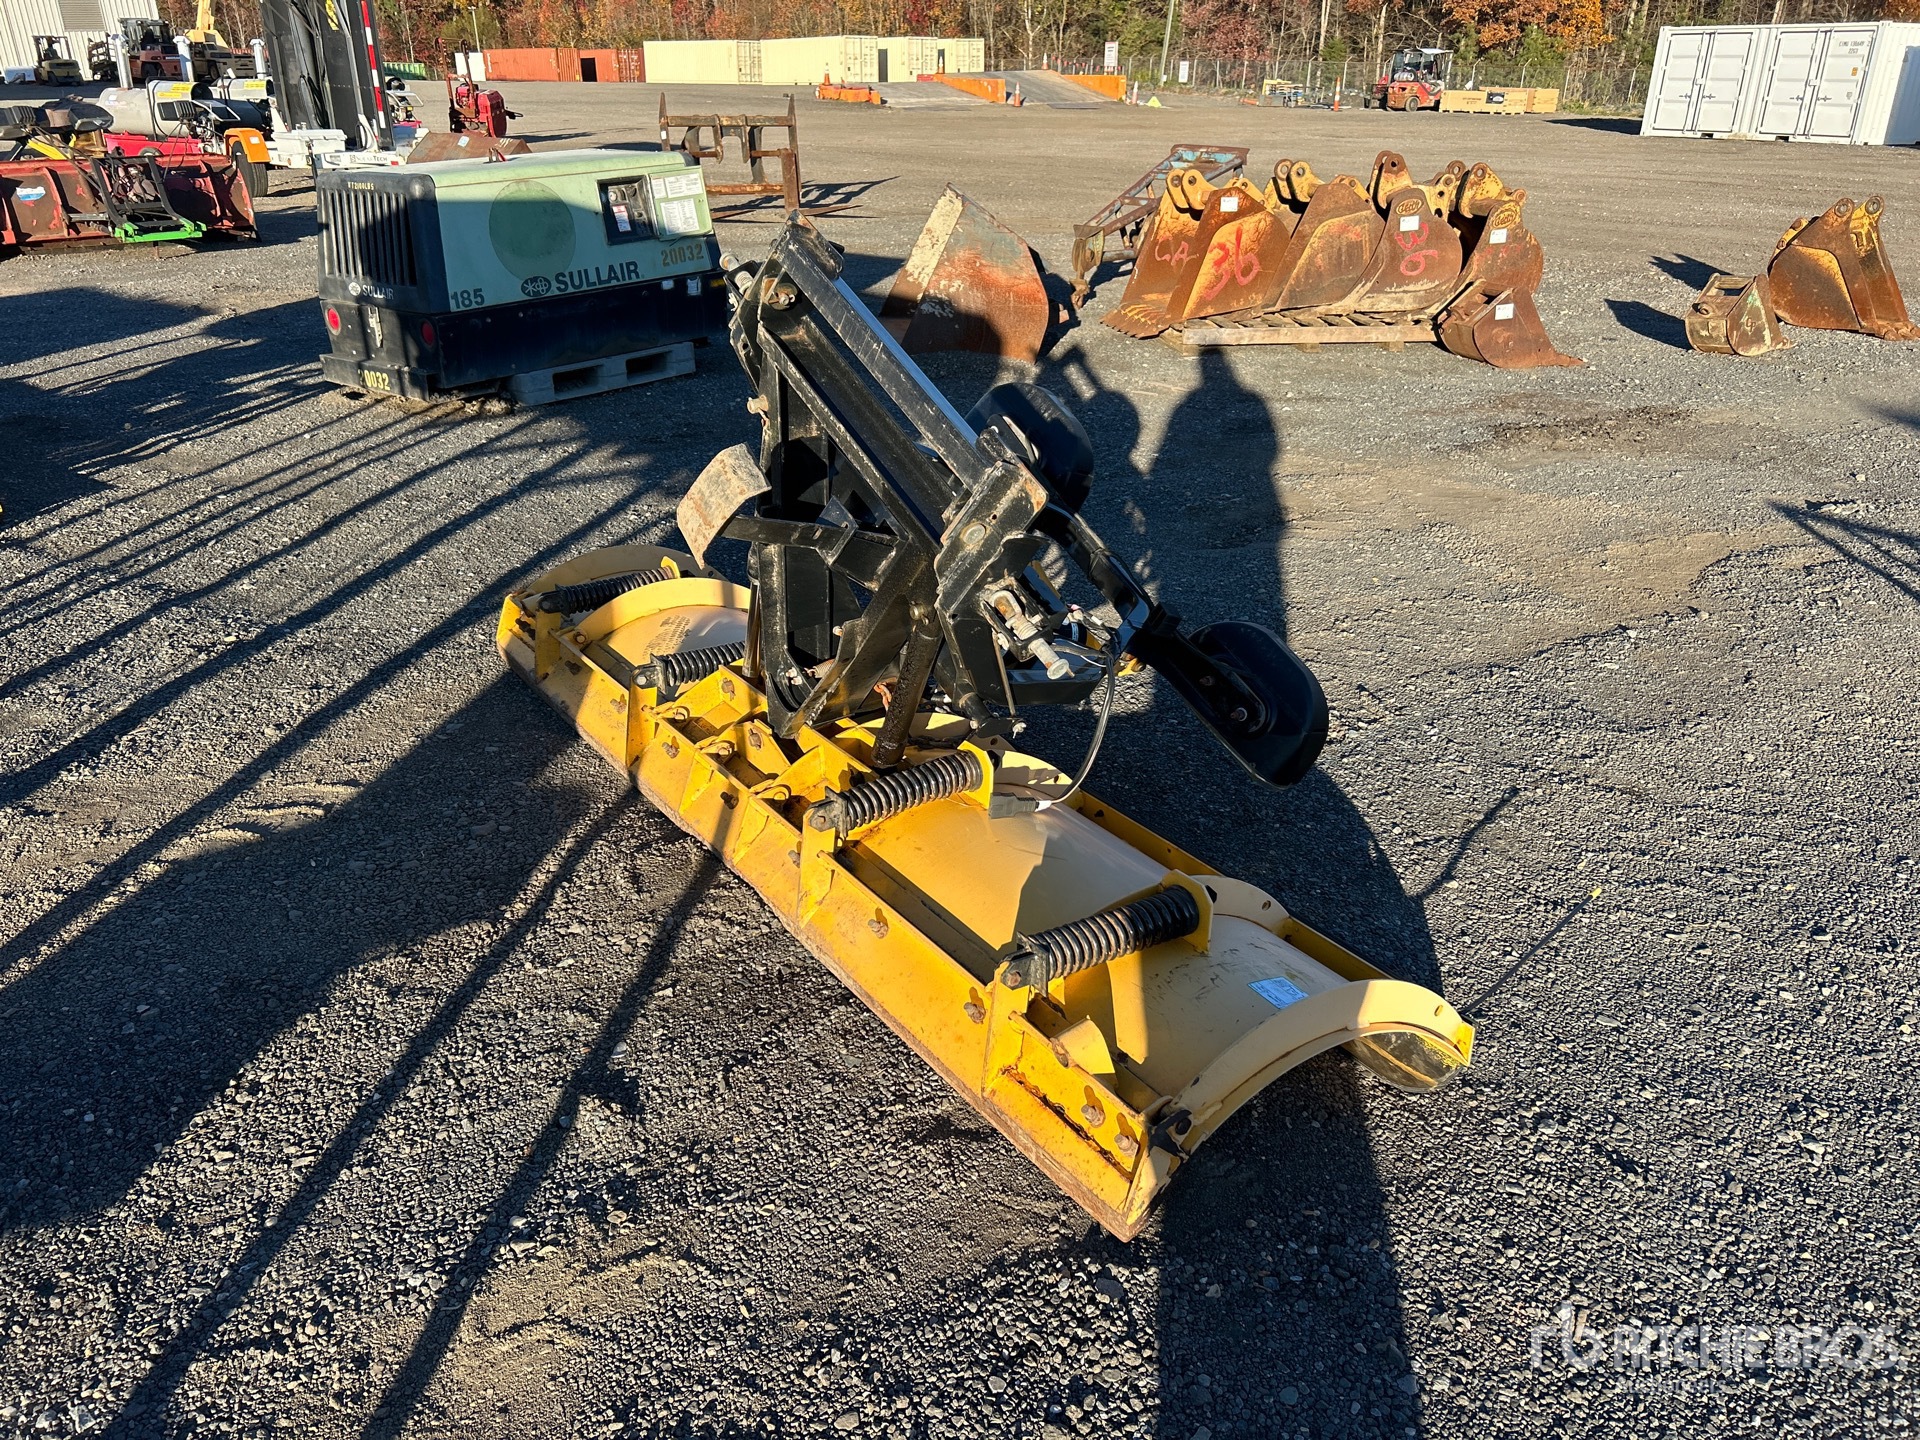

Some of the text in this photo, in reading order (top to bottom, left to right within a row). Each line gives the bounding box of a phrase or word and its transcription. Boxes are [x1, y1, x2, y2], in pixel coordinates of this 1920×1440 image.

[661, 243, 705, 267] 20032
[1203, 226, 1260, 301] 36
[555, 260, 640, 293] SULLAIR
[362, 284, 394, 300] SULLAIR
[450, 287, 485, 309] 185
